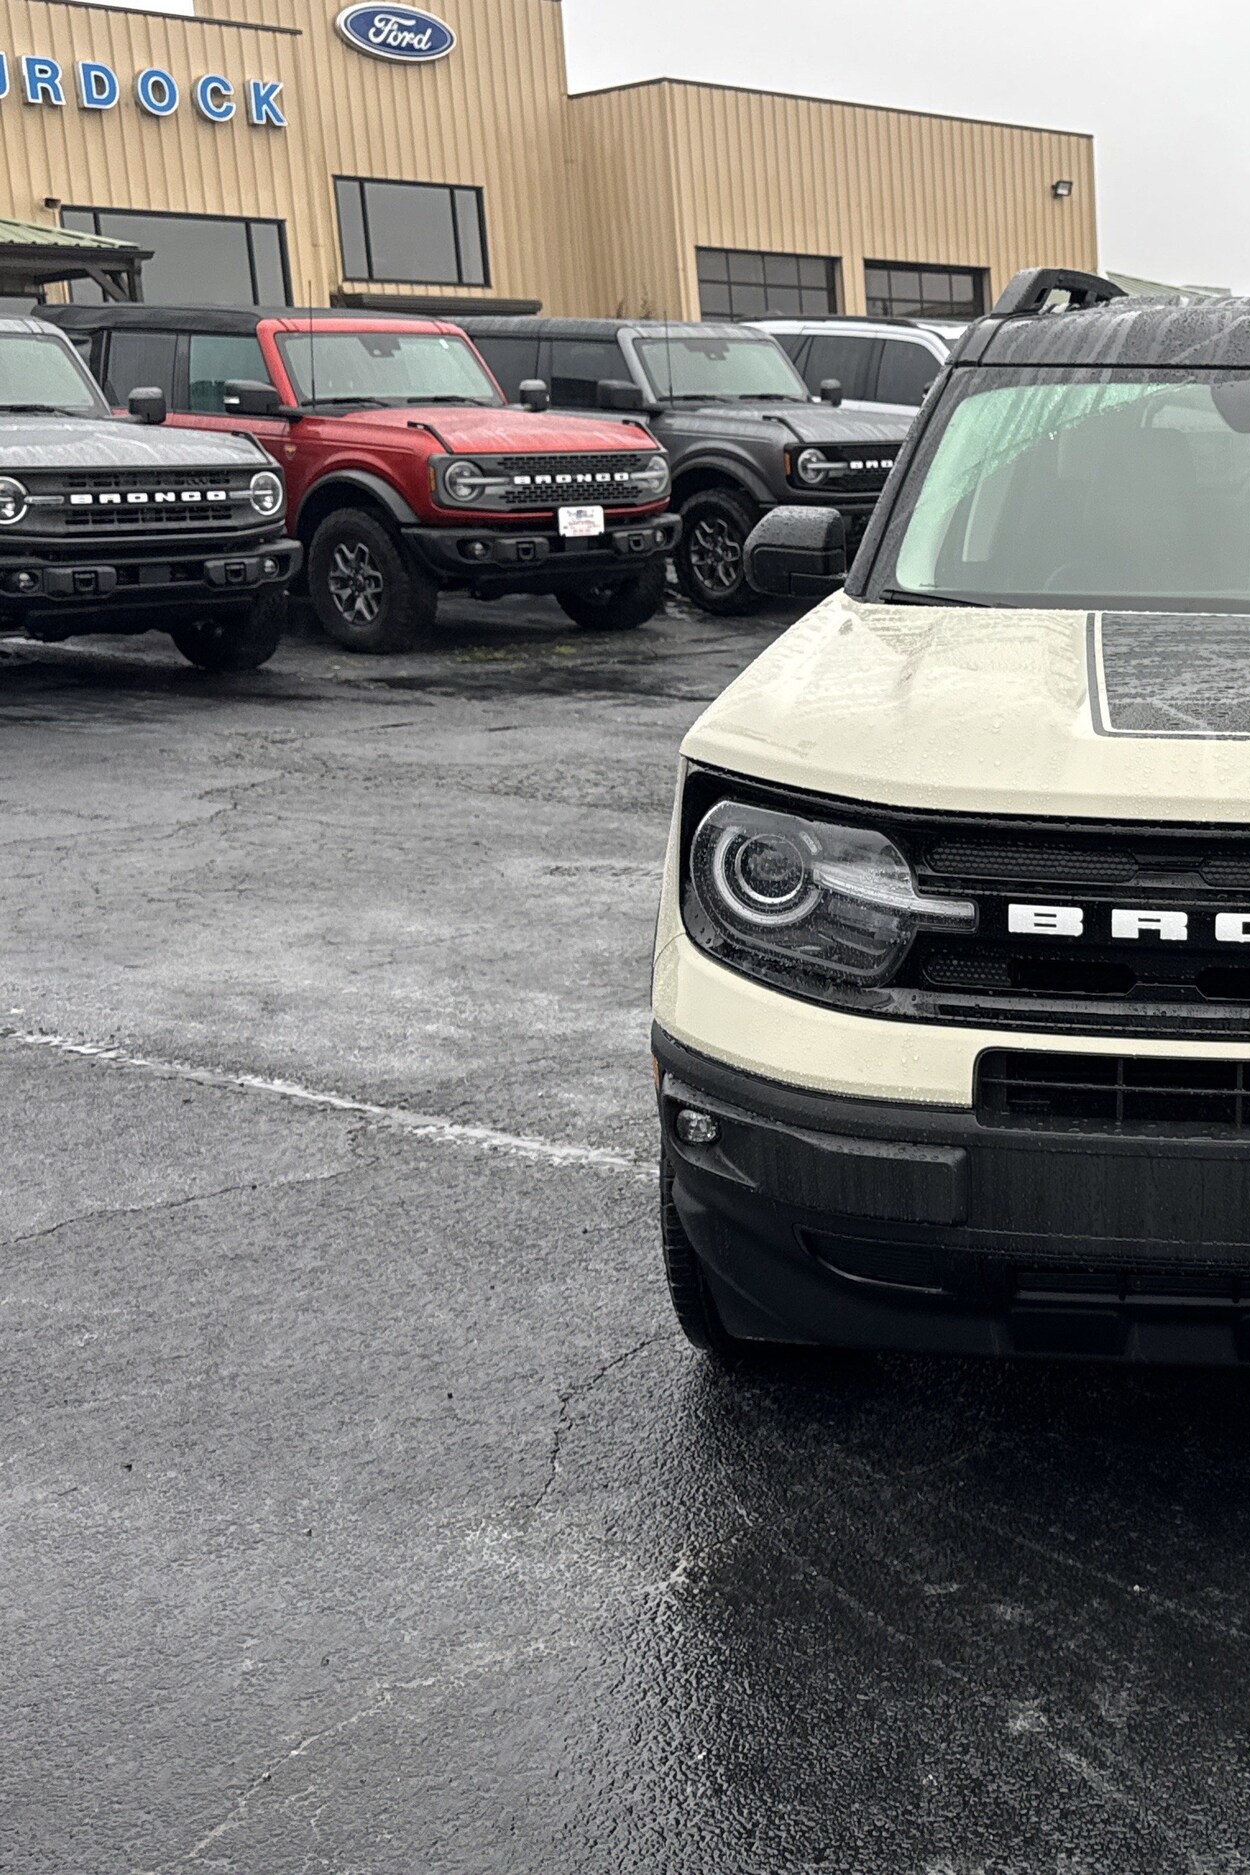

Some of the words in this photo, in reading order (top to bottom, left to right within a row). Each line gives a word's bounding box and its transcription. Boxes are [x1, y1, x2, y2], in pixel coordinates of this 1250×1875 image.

[368, 13, 432, 50] Ford
[0, 51, 286, 127] RDOCK
[513, 472, 629, 484] BRONCO
[70, 490, 226, 504] BRONCO
